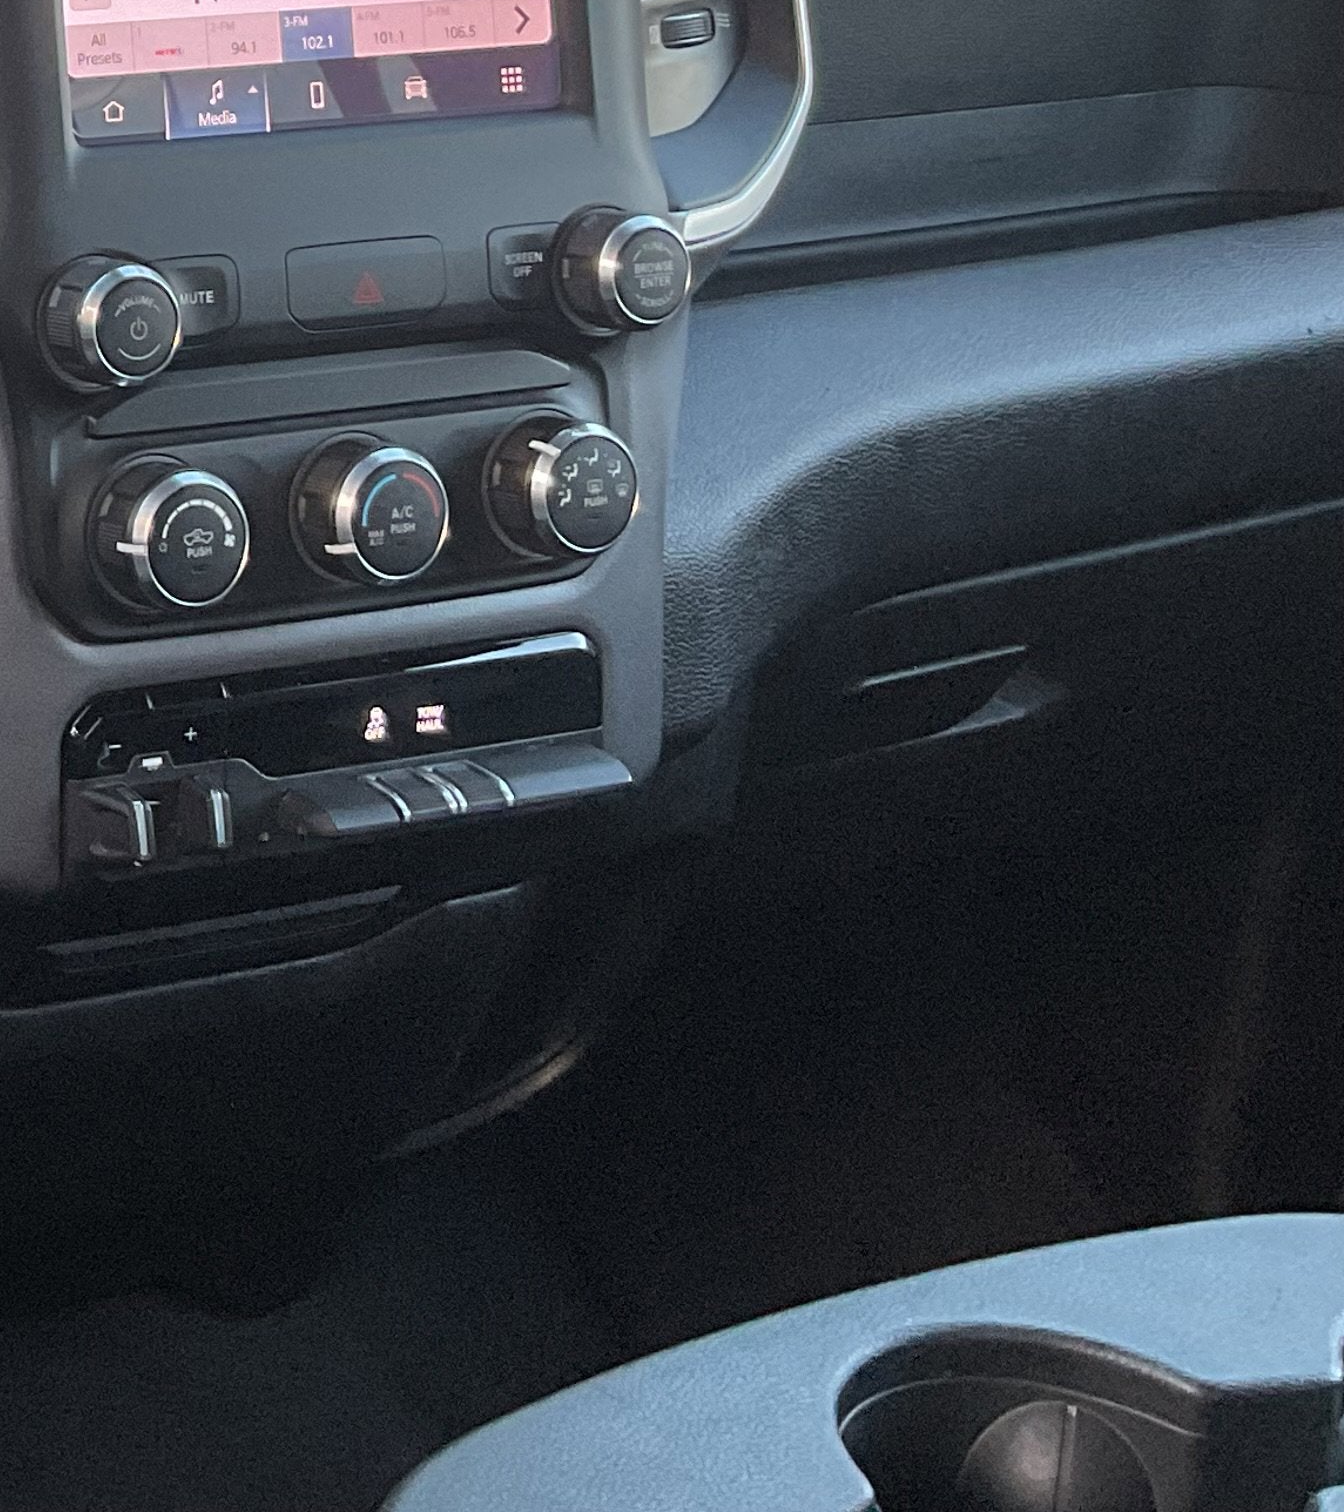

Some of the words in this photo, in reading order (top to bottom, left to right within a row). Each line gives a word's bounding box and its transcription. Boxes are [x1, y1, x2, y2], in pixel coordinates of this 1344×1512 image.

[283, 15, 309, 27] 3-FM
[91, 32, 107, 47] All
[373, 30, 405, 45] 101.1
[443, 25, 477, 39] 106.5
[231, 40, 257, 55] 94.1
[301, 35, 334, 50] 102.1
[76, 50, 123, 67] Presets
[197, 110, 237, 128] Media
[504, 251, 544, 266] SCREEN
[513, 265, 533, 279] OFF
[634, 261, 675, 275] BROWSE
[639, 275, 672, 289] ENTER
[178, 289, 215, 306] MUTE
[391, 504, 415, 520] A/C
[185, 545, 213, 559] PUSH
